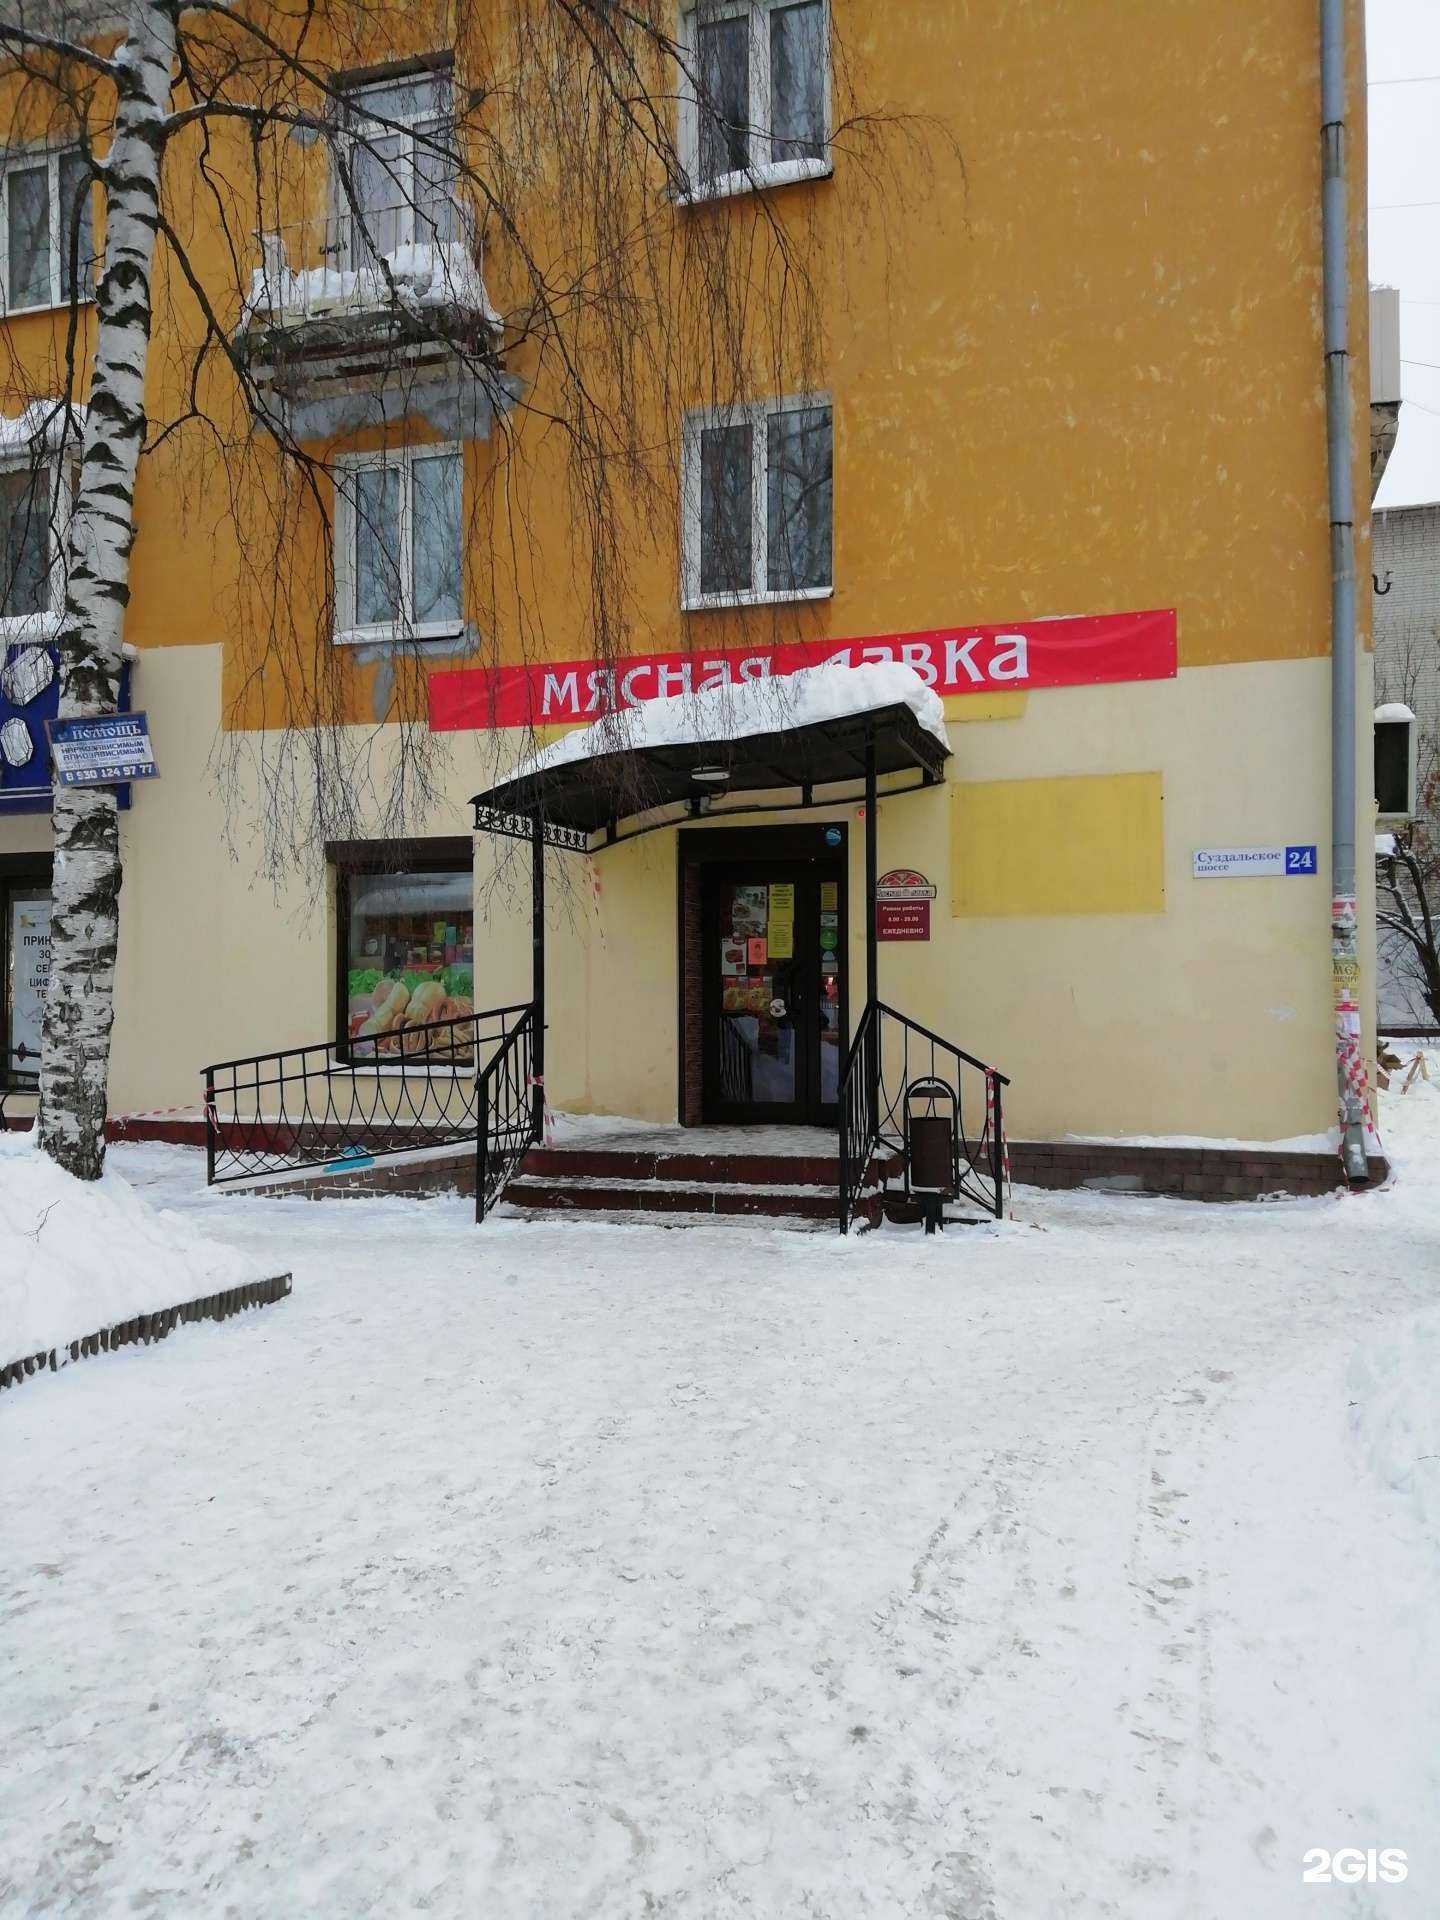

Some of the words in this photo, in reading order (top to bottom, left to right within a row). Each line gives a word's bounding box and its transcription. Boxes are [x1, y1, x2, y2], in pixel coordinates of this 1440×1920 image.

[65, 772, 74, 781] 8
[76, 769, 98, 780] 930
[101, 767, 121, 778] 124
[123, 765, 136, 776] 97
[139, 764, 152, 774] 77
[1197, 852, 1281, 864] Суздальское
[1288, 851, 1313, 869] 24
[1198, 864, 1229, 872] шоссе
